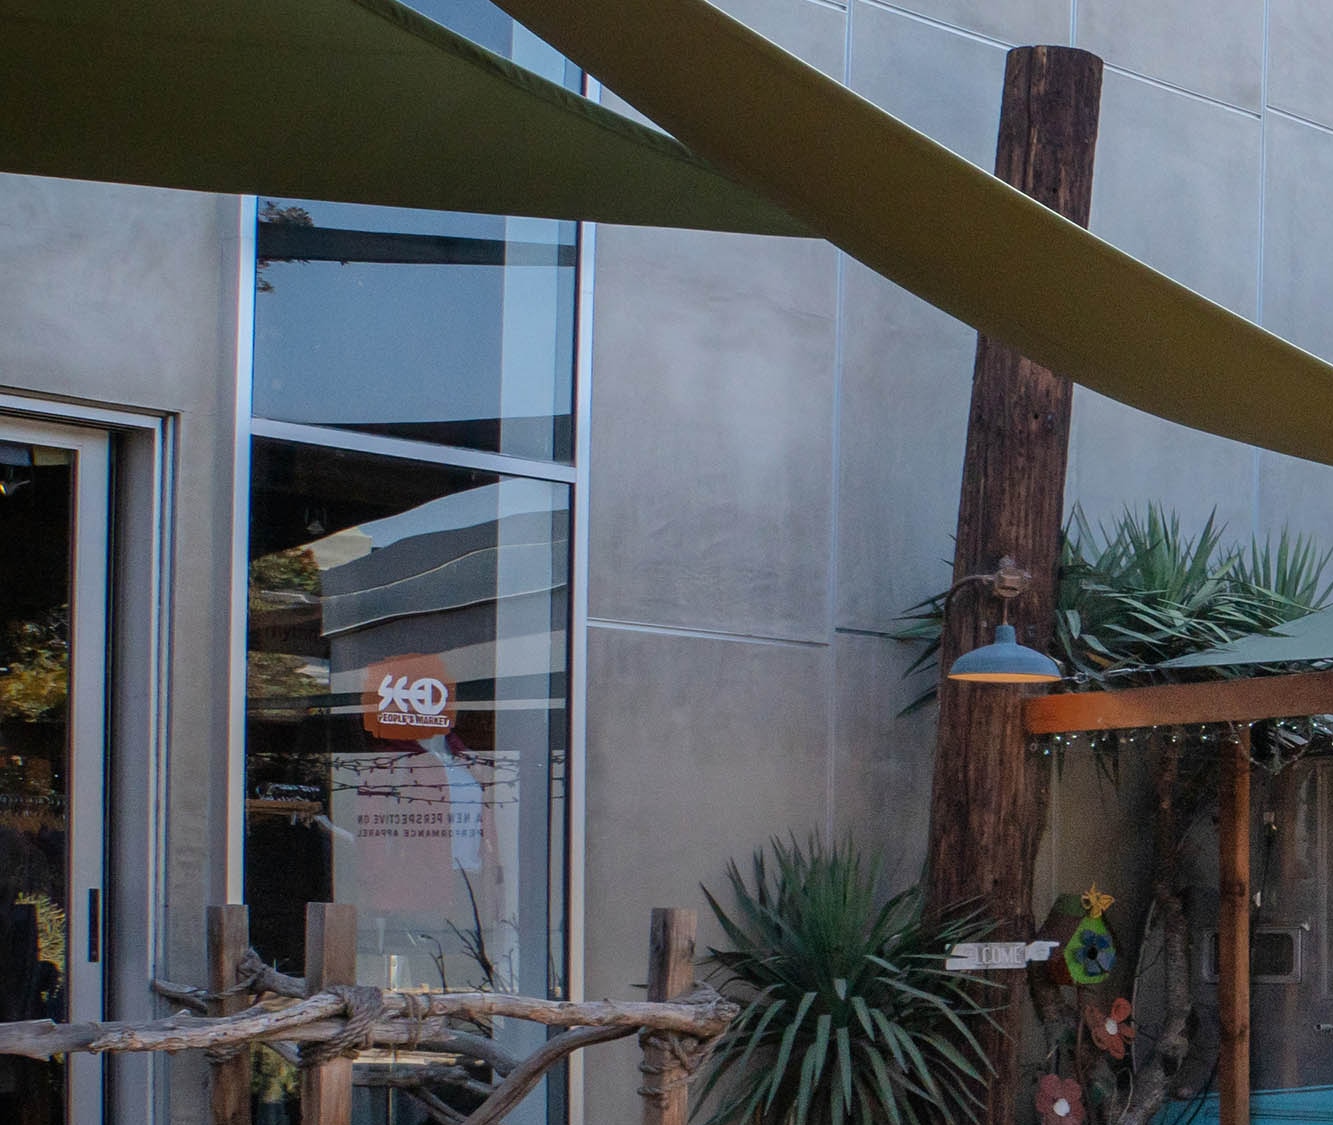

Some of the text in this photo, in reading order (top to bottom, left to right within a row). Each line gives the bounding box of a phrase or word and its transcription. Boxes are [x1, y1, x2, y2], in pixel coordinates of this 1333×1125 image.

[377, 674, 449, 715] SEED
[378, 712, 449, 728] PEOPLE'S MARKET
